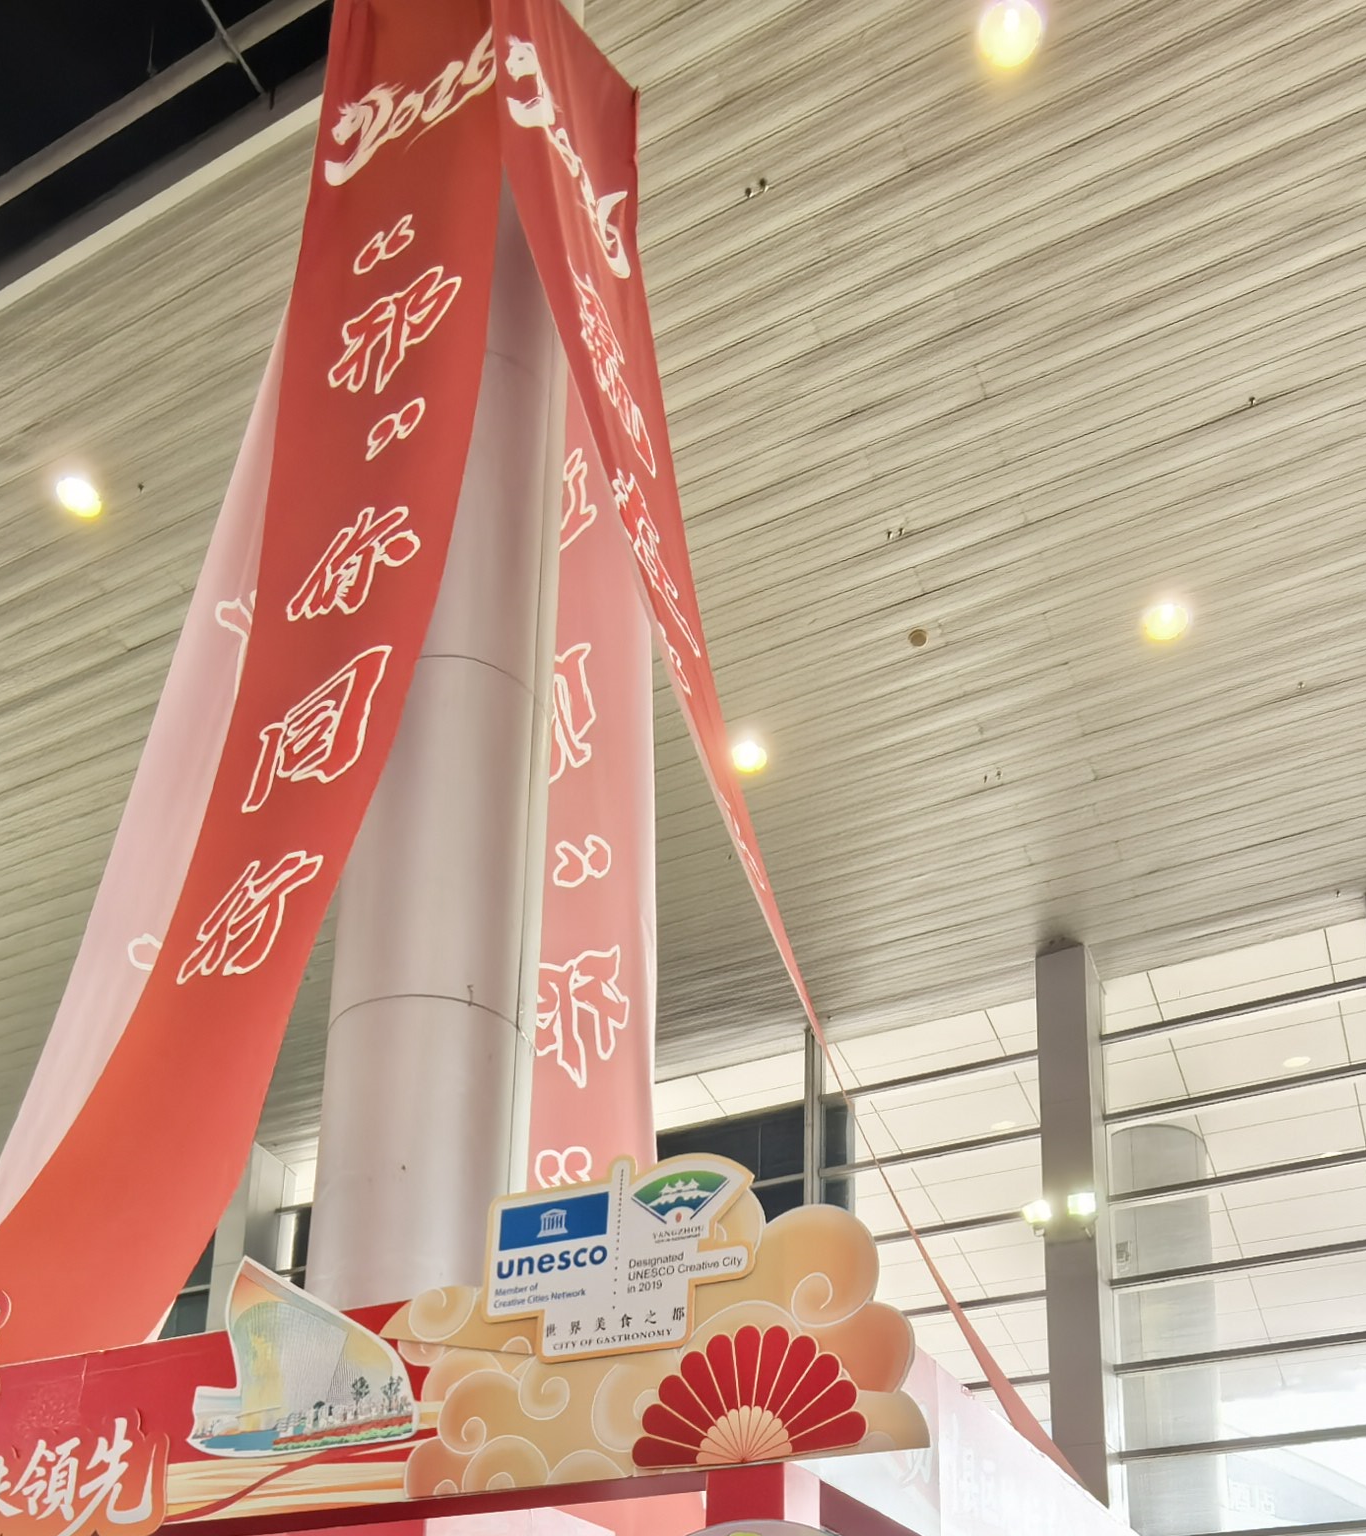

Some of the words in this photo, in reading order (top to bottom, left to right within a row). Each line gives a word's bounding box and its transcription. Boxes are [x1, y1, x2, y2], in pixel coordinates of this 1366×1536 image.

[496, 1245, 608, 1280] unesco
[627, 1265, 675, 1281] UNESCO
[677, 1260, 720, 1274] Creative
[722, 1256, 743, 1268] City
[628, 1251, 685, 1269] Designated
[495, 1285, 528, 1297] Member
[529, 1282, 539, 1292] of
[626, 1282, 636, 1294] in
[638, 1280, 663, 1293] 2019
[493, 1297, 526, 1309] Creative
[527, 1294, 550, 1305] Cities
[550, 1288, 586, 1301] Network
[545, 1306, 685, 1338] 世界美食之都
[553, 1339, 577, 1351] CITY
[580, 1338, 594, 1347] OF
[596, 1328, 673, 1345] GASTRONOMY
